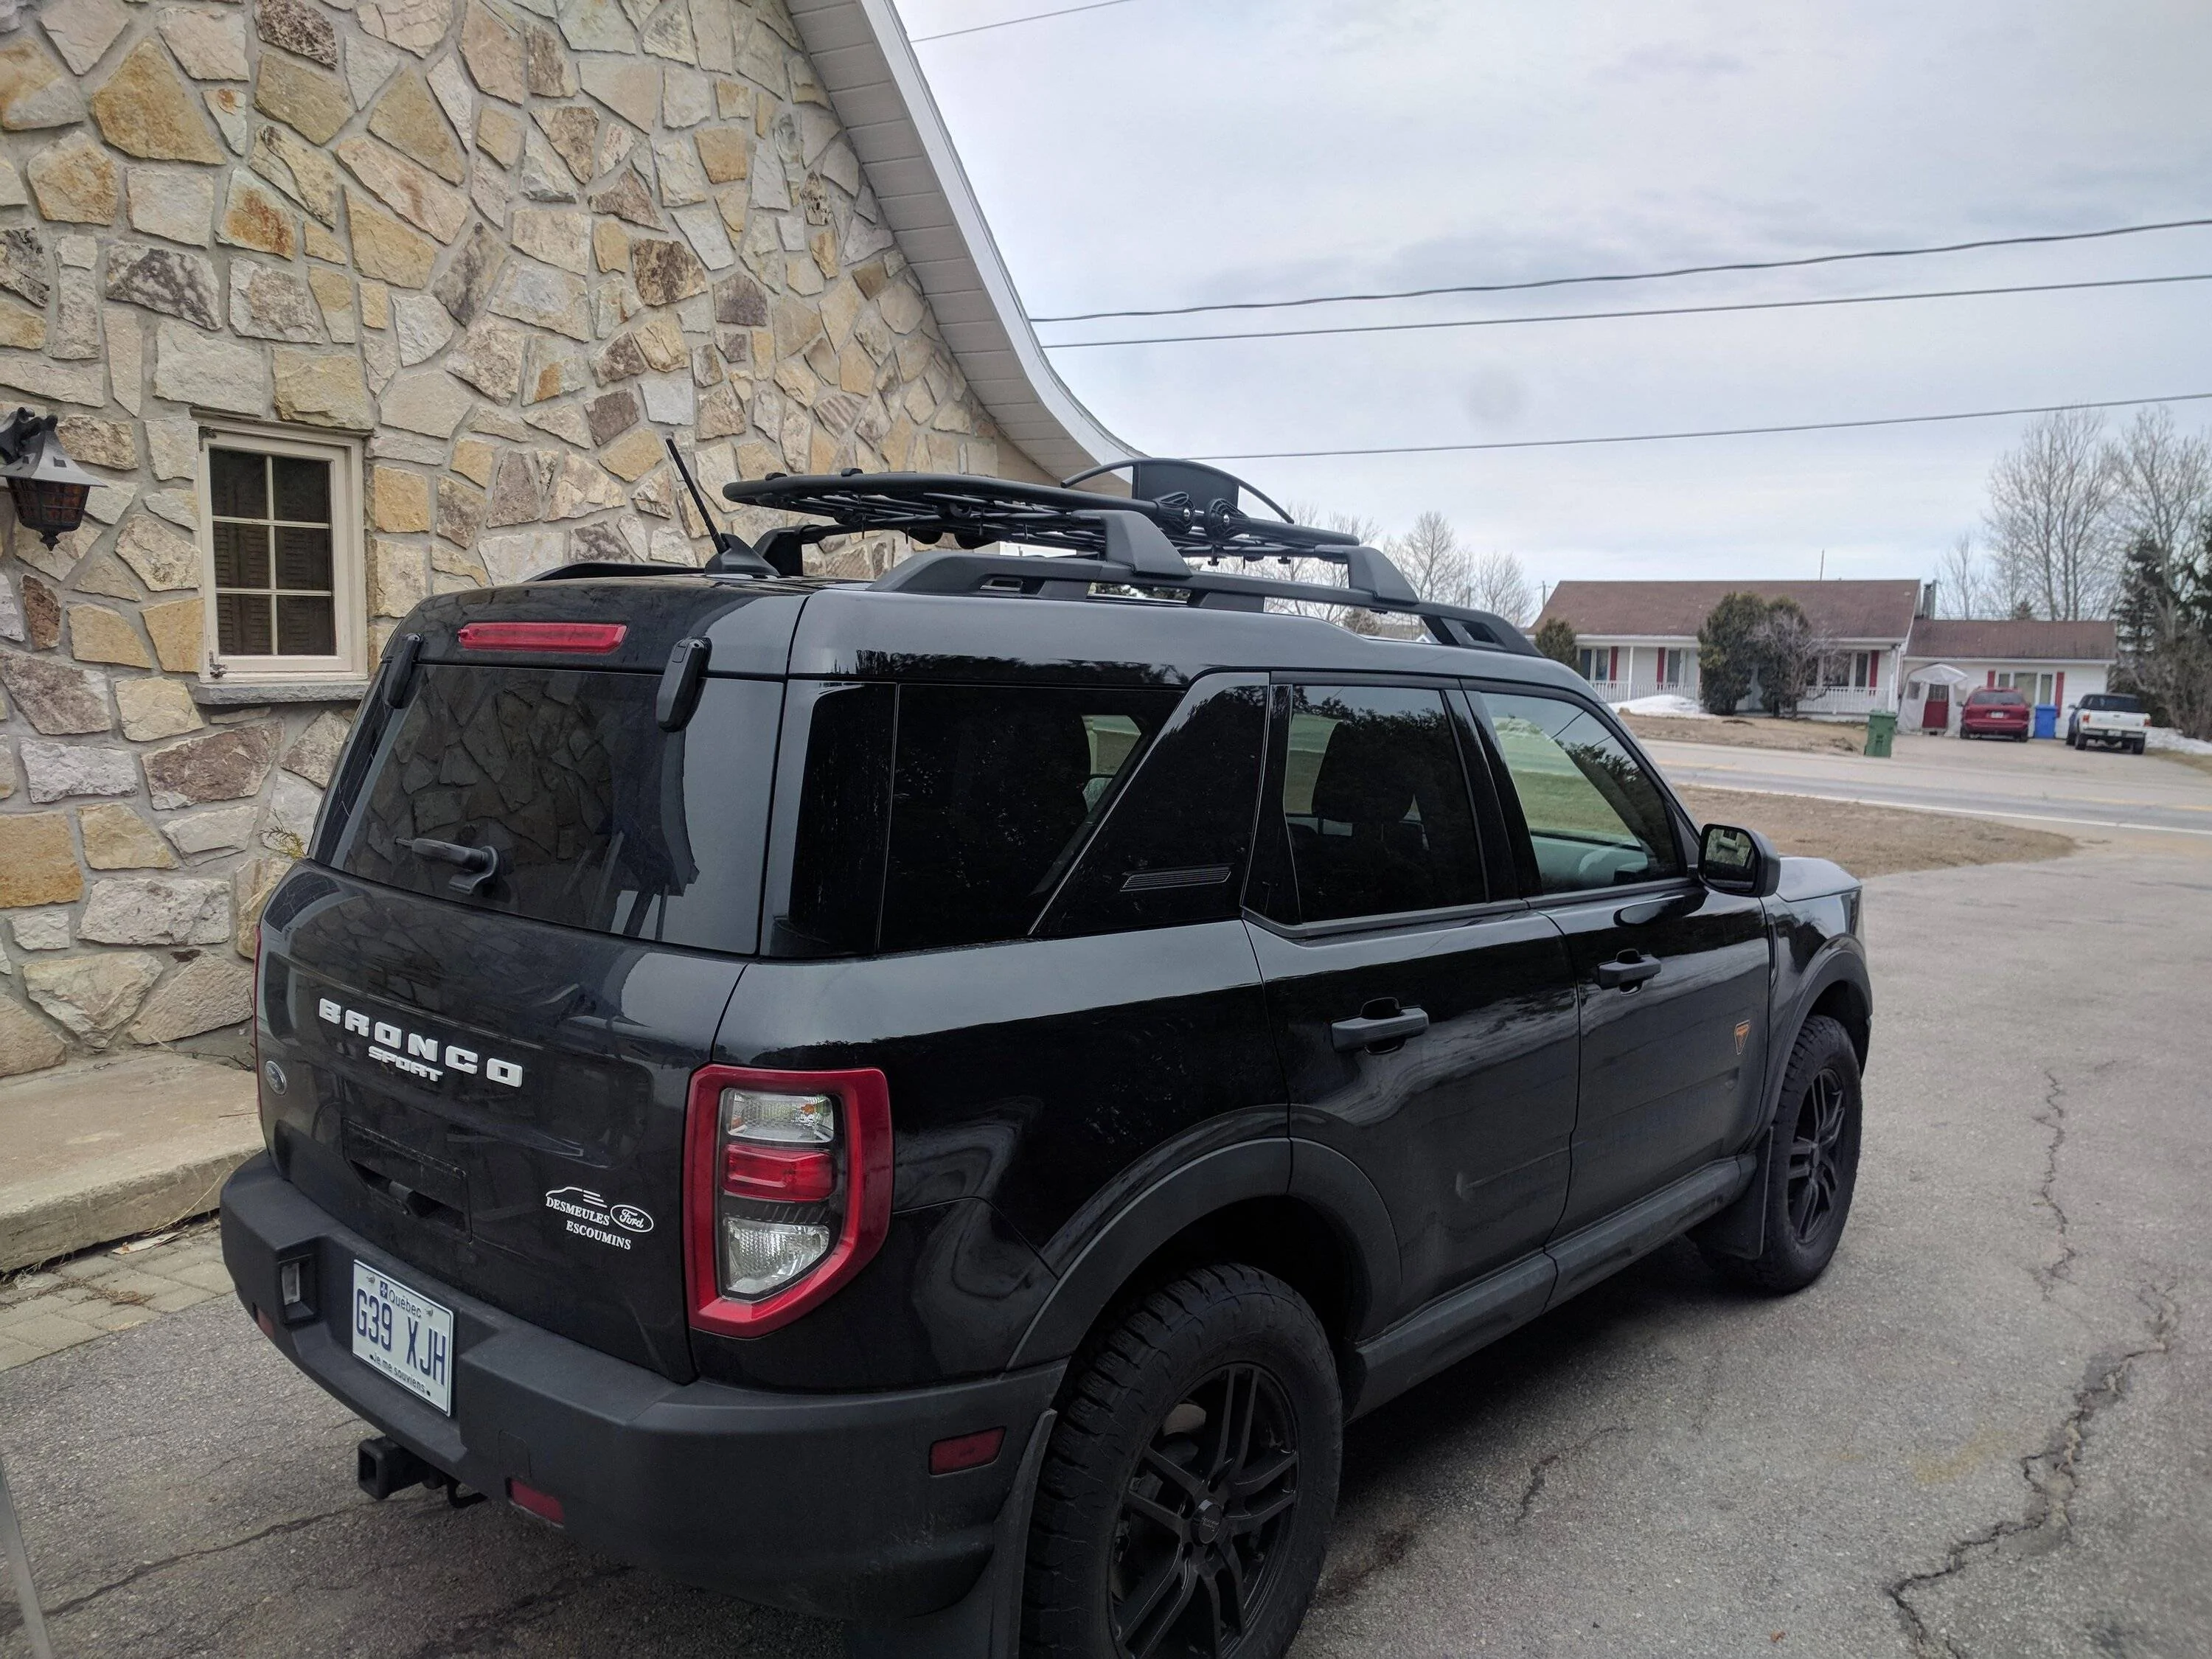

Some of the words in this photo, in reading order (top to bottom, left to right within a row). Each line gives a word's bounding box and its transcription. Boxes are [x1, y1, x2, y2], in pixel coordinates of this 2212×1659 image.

[319, 998, 523, 1088] BRONCO
[368, 1046, 443, 1082] SPORT
[546, 1197, 610, 1225] DESMEULES
[619, 1209, 644, 1228] Ford
[566, 1220, 631, 1250] ESCOUMINS
[389, 1289, 422, 1318] Québec
[356, 1287, 392, 1352] G39
[406, 1316, 447, 1386] XJH
[383, 1360, 392, 1372] me
[394, 1366, 425, 1393] souviens
